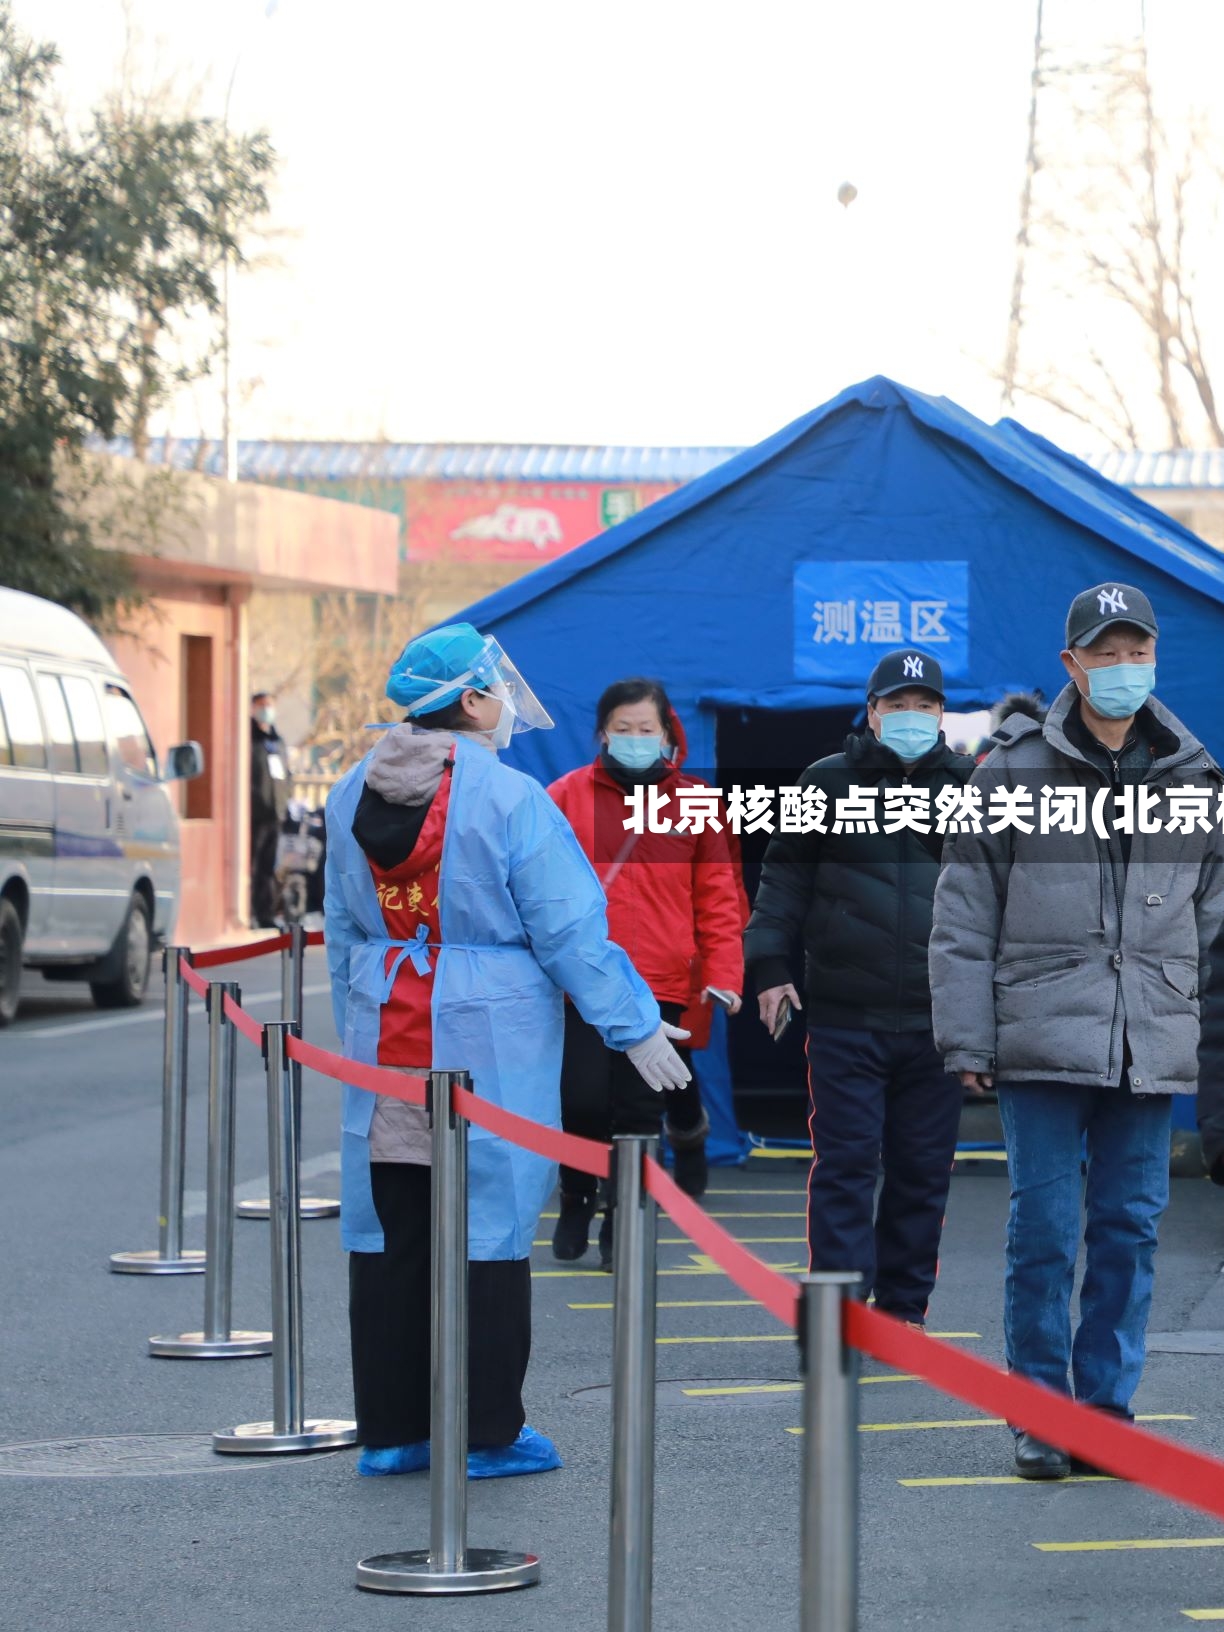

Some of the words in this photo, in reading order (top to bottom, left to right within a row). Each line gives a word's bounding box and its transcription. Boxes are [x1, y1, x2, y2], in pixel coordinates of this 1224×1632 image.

[1096, 587, 1128, 616] NY
[811, 599, 950, 645] 测温区
[903, 655, 924, 678] NY
